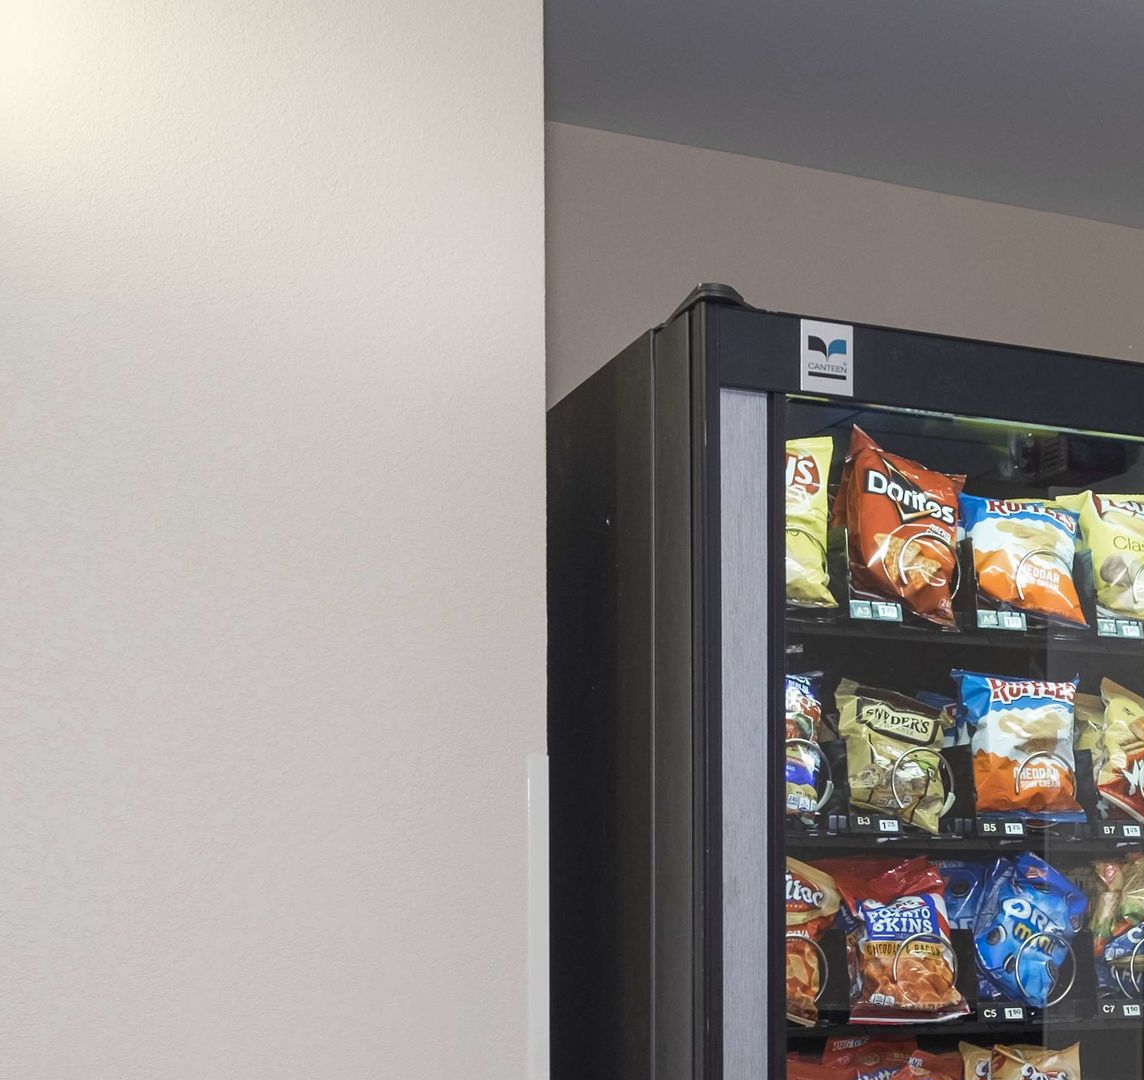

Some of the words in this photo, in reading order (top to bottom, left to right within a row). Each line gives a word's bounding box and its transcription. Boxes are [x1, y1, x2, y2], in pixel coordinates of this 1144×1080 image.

[808, 362, 848, 374] CANTEEN
[867, 470, 955, 524] Doritos
[857, 608, 870, 617] A3
[1103, 623, 1114, 632] A7
[989, 679, 1076, 703] RUFFLES
[866, 708, 930, 735] SNYDER'S
[858, 817, 871, 825] B3
[984, 823, 997, 832] B5
[872, 918, 934, 934] SKINS
[1102, 1004, 1115, 1013] C7
[984, 1010, 997, 1018] C5
